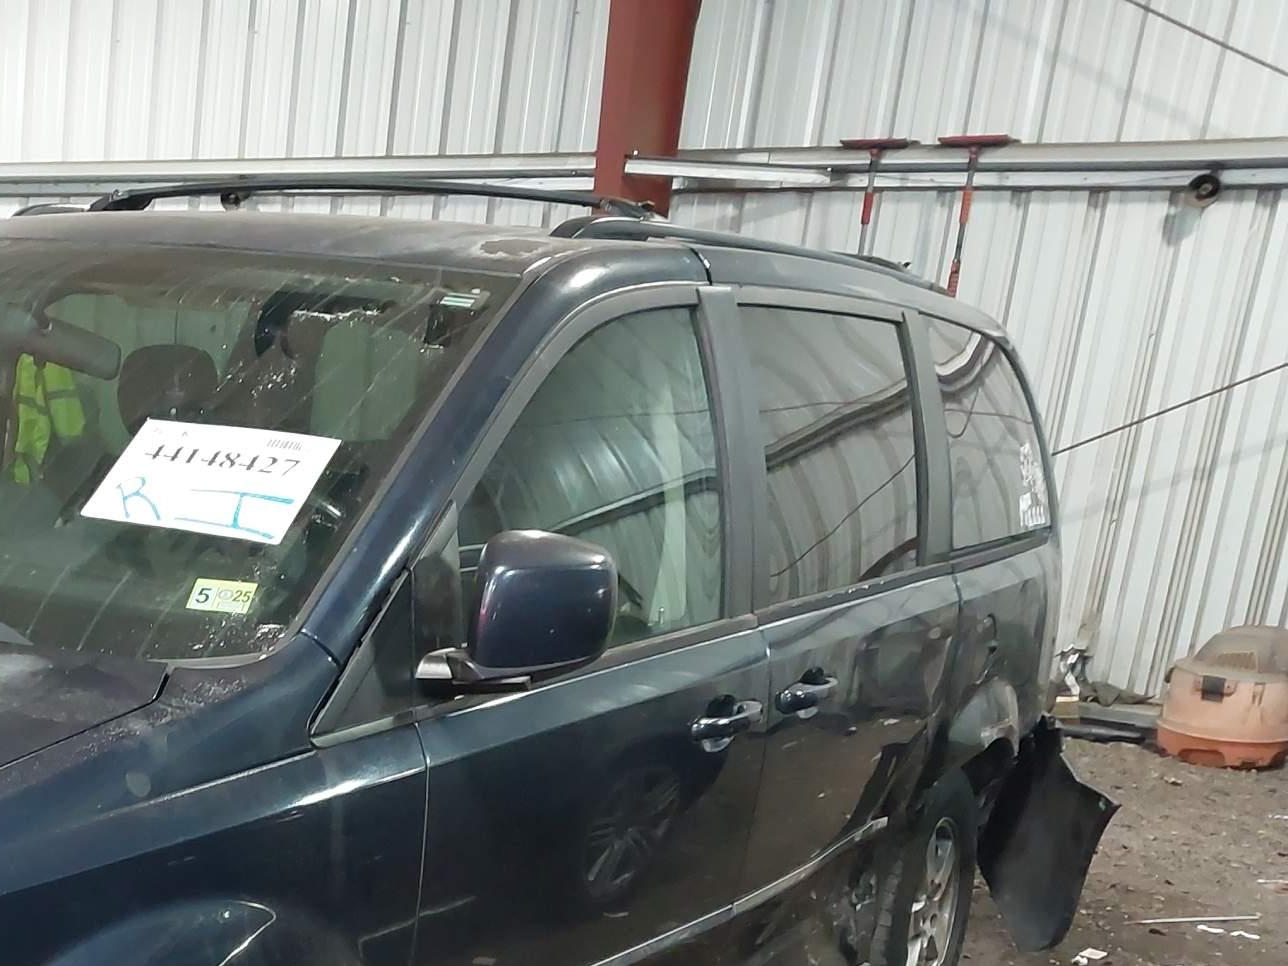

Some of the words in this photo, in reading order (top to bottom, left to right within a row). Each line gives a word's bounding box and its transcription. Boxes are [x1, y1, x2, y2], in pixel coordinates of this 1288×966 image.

[145, 444, 302, 477] 44148427
[116, 476, 161, 521] R
[195, 587, 212, 604] 5
[231, 590, 252, 603] 25
